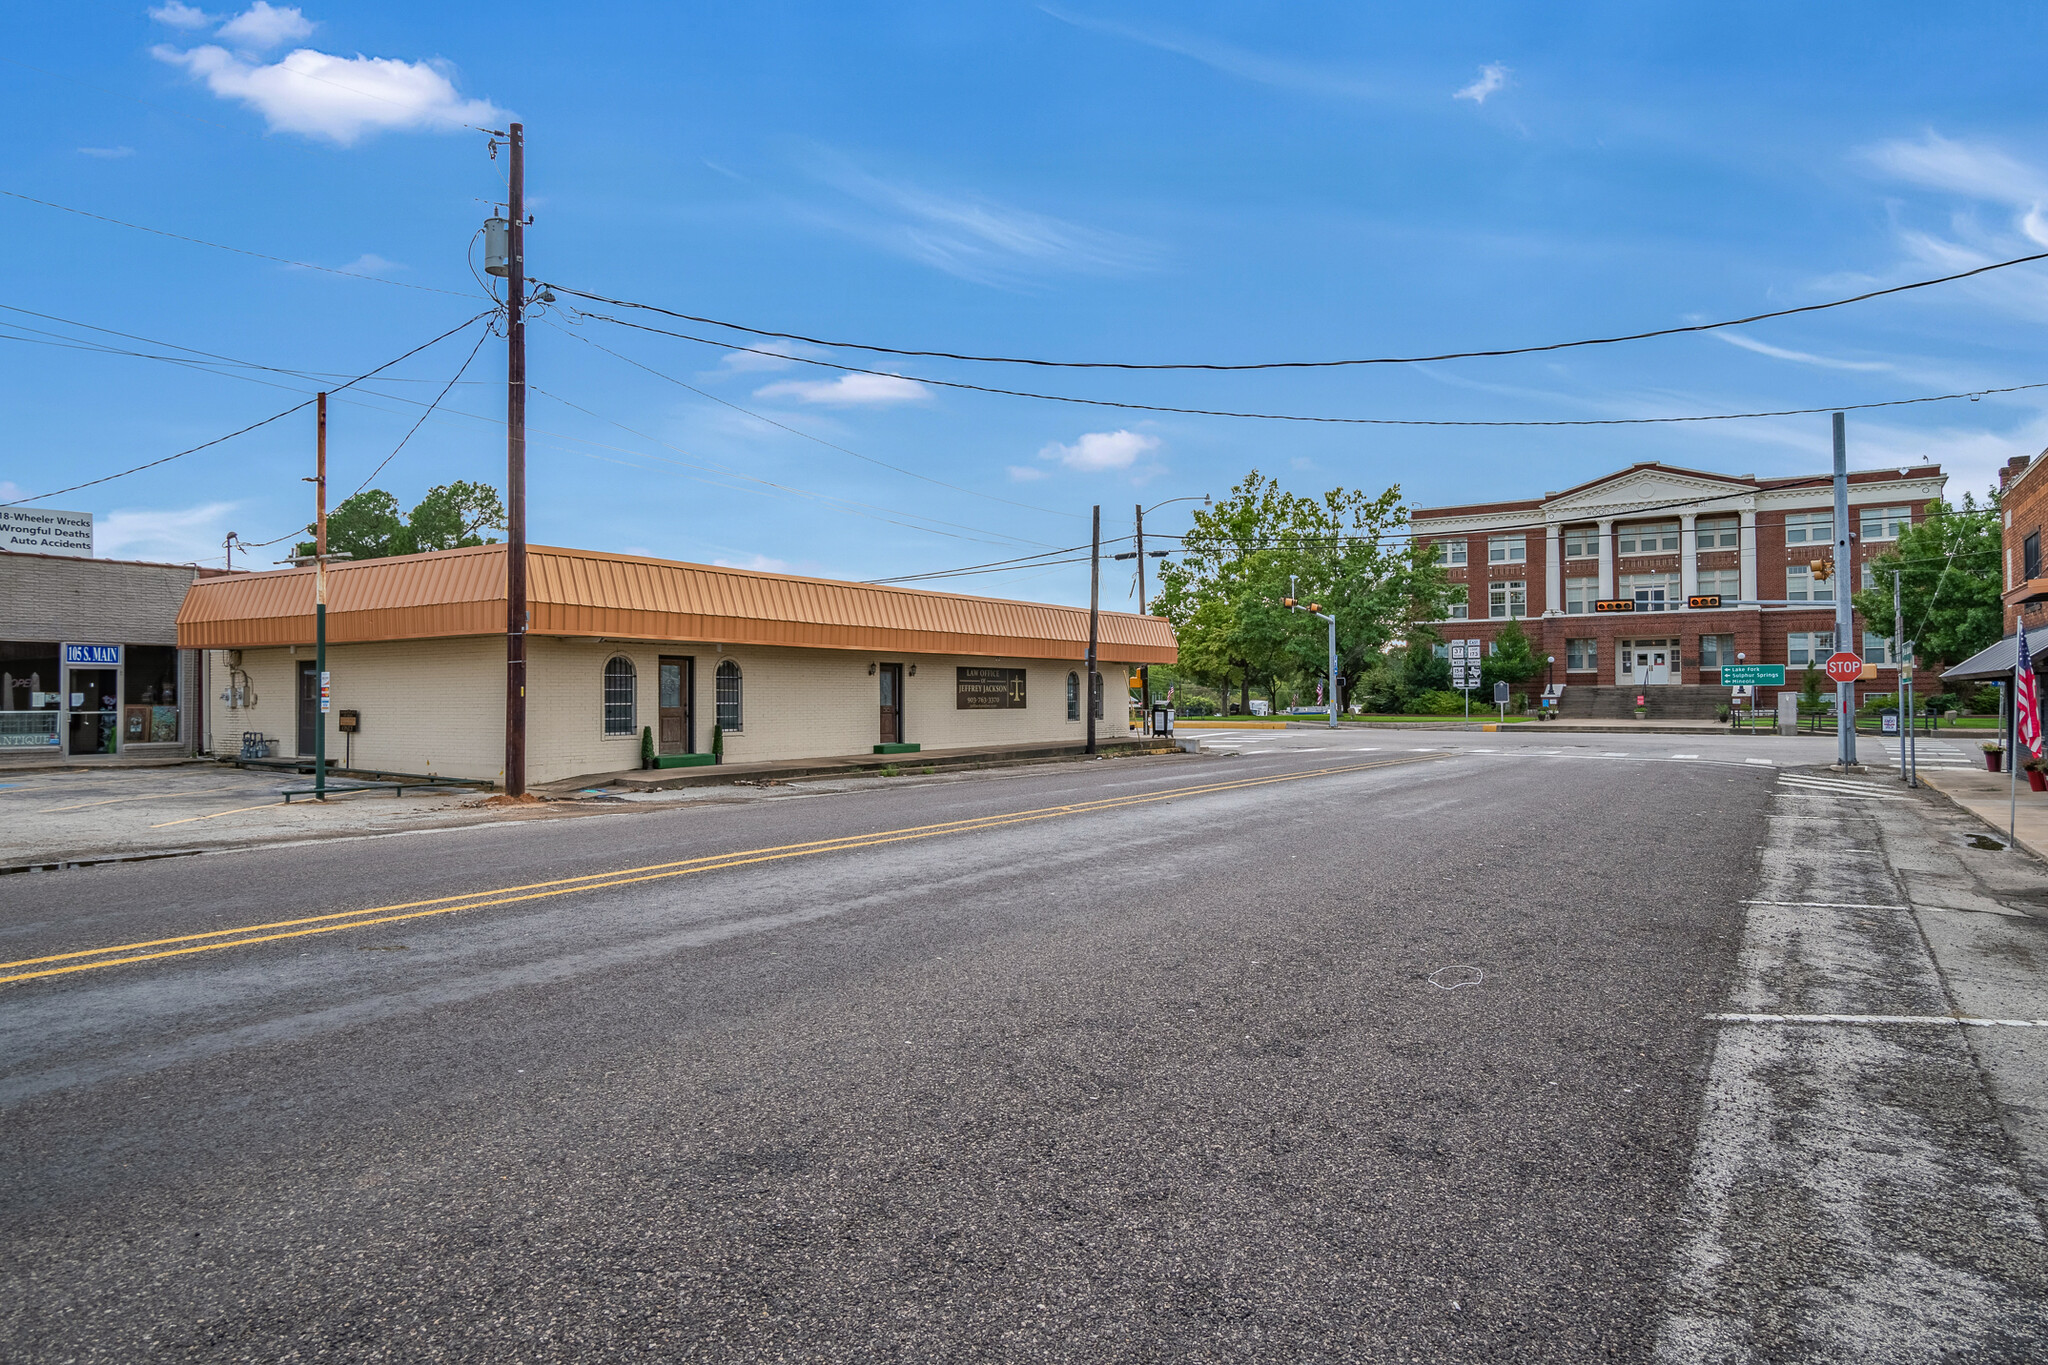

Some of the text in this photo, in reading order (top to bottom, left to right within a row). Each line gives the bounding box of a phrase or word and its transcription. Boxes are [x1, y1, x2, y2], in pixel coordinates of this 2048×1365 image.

[57, 516, 91, 527] Wrecks
[0, 523, 90, 538] Wrongful Deaths
[10, 536, 92, 550] Auto Accidents
[68, 646, 117, 661] 105 S. MAIN
[1829, 661, 1860, 673] STOP
[959, 685, 1007, 693] JEFFREY JACKSON
